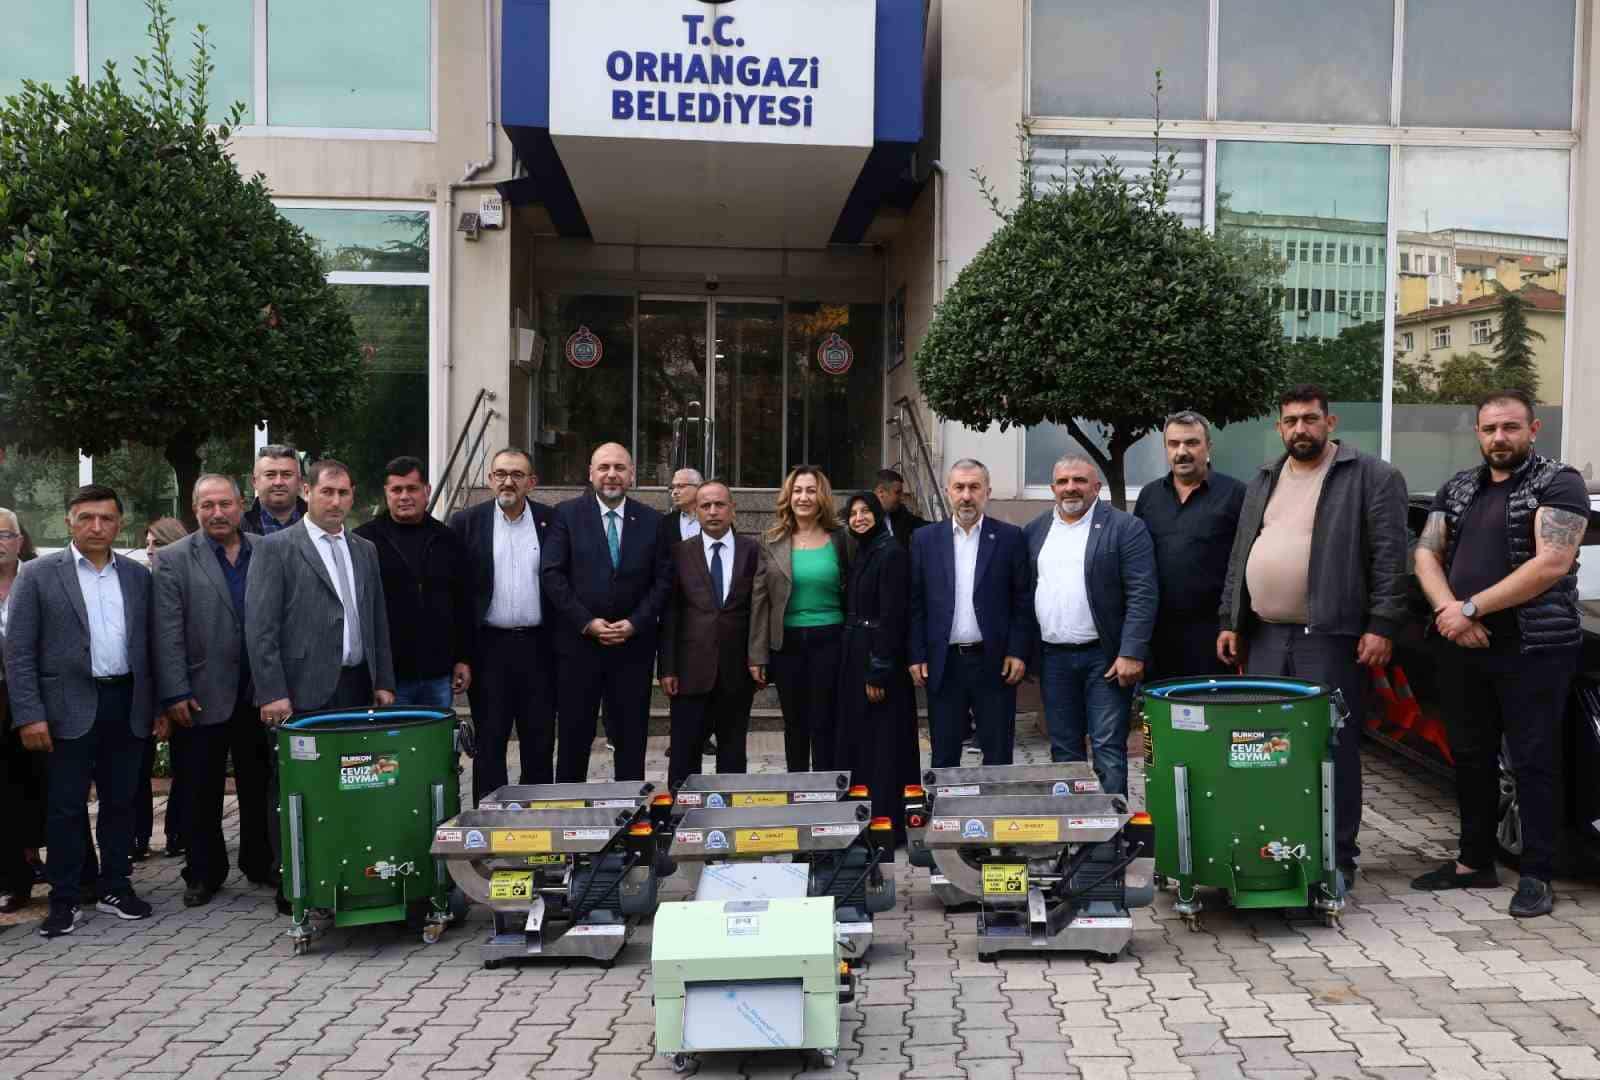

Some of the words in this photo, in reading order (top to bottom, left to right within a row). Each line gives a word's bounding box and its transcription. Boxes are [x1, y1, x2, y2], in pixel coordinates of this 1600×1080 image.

[682, 14, 745, 47] T.C.
[1231, 752, 1271, 761] SOYMA
[341, 773, 379, 784] SOYMA
